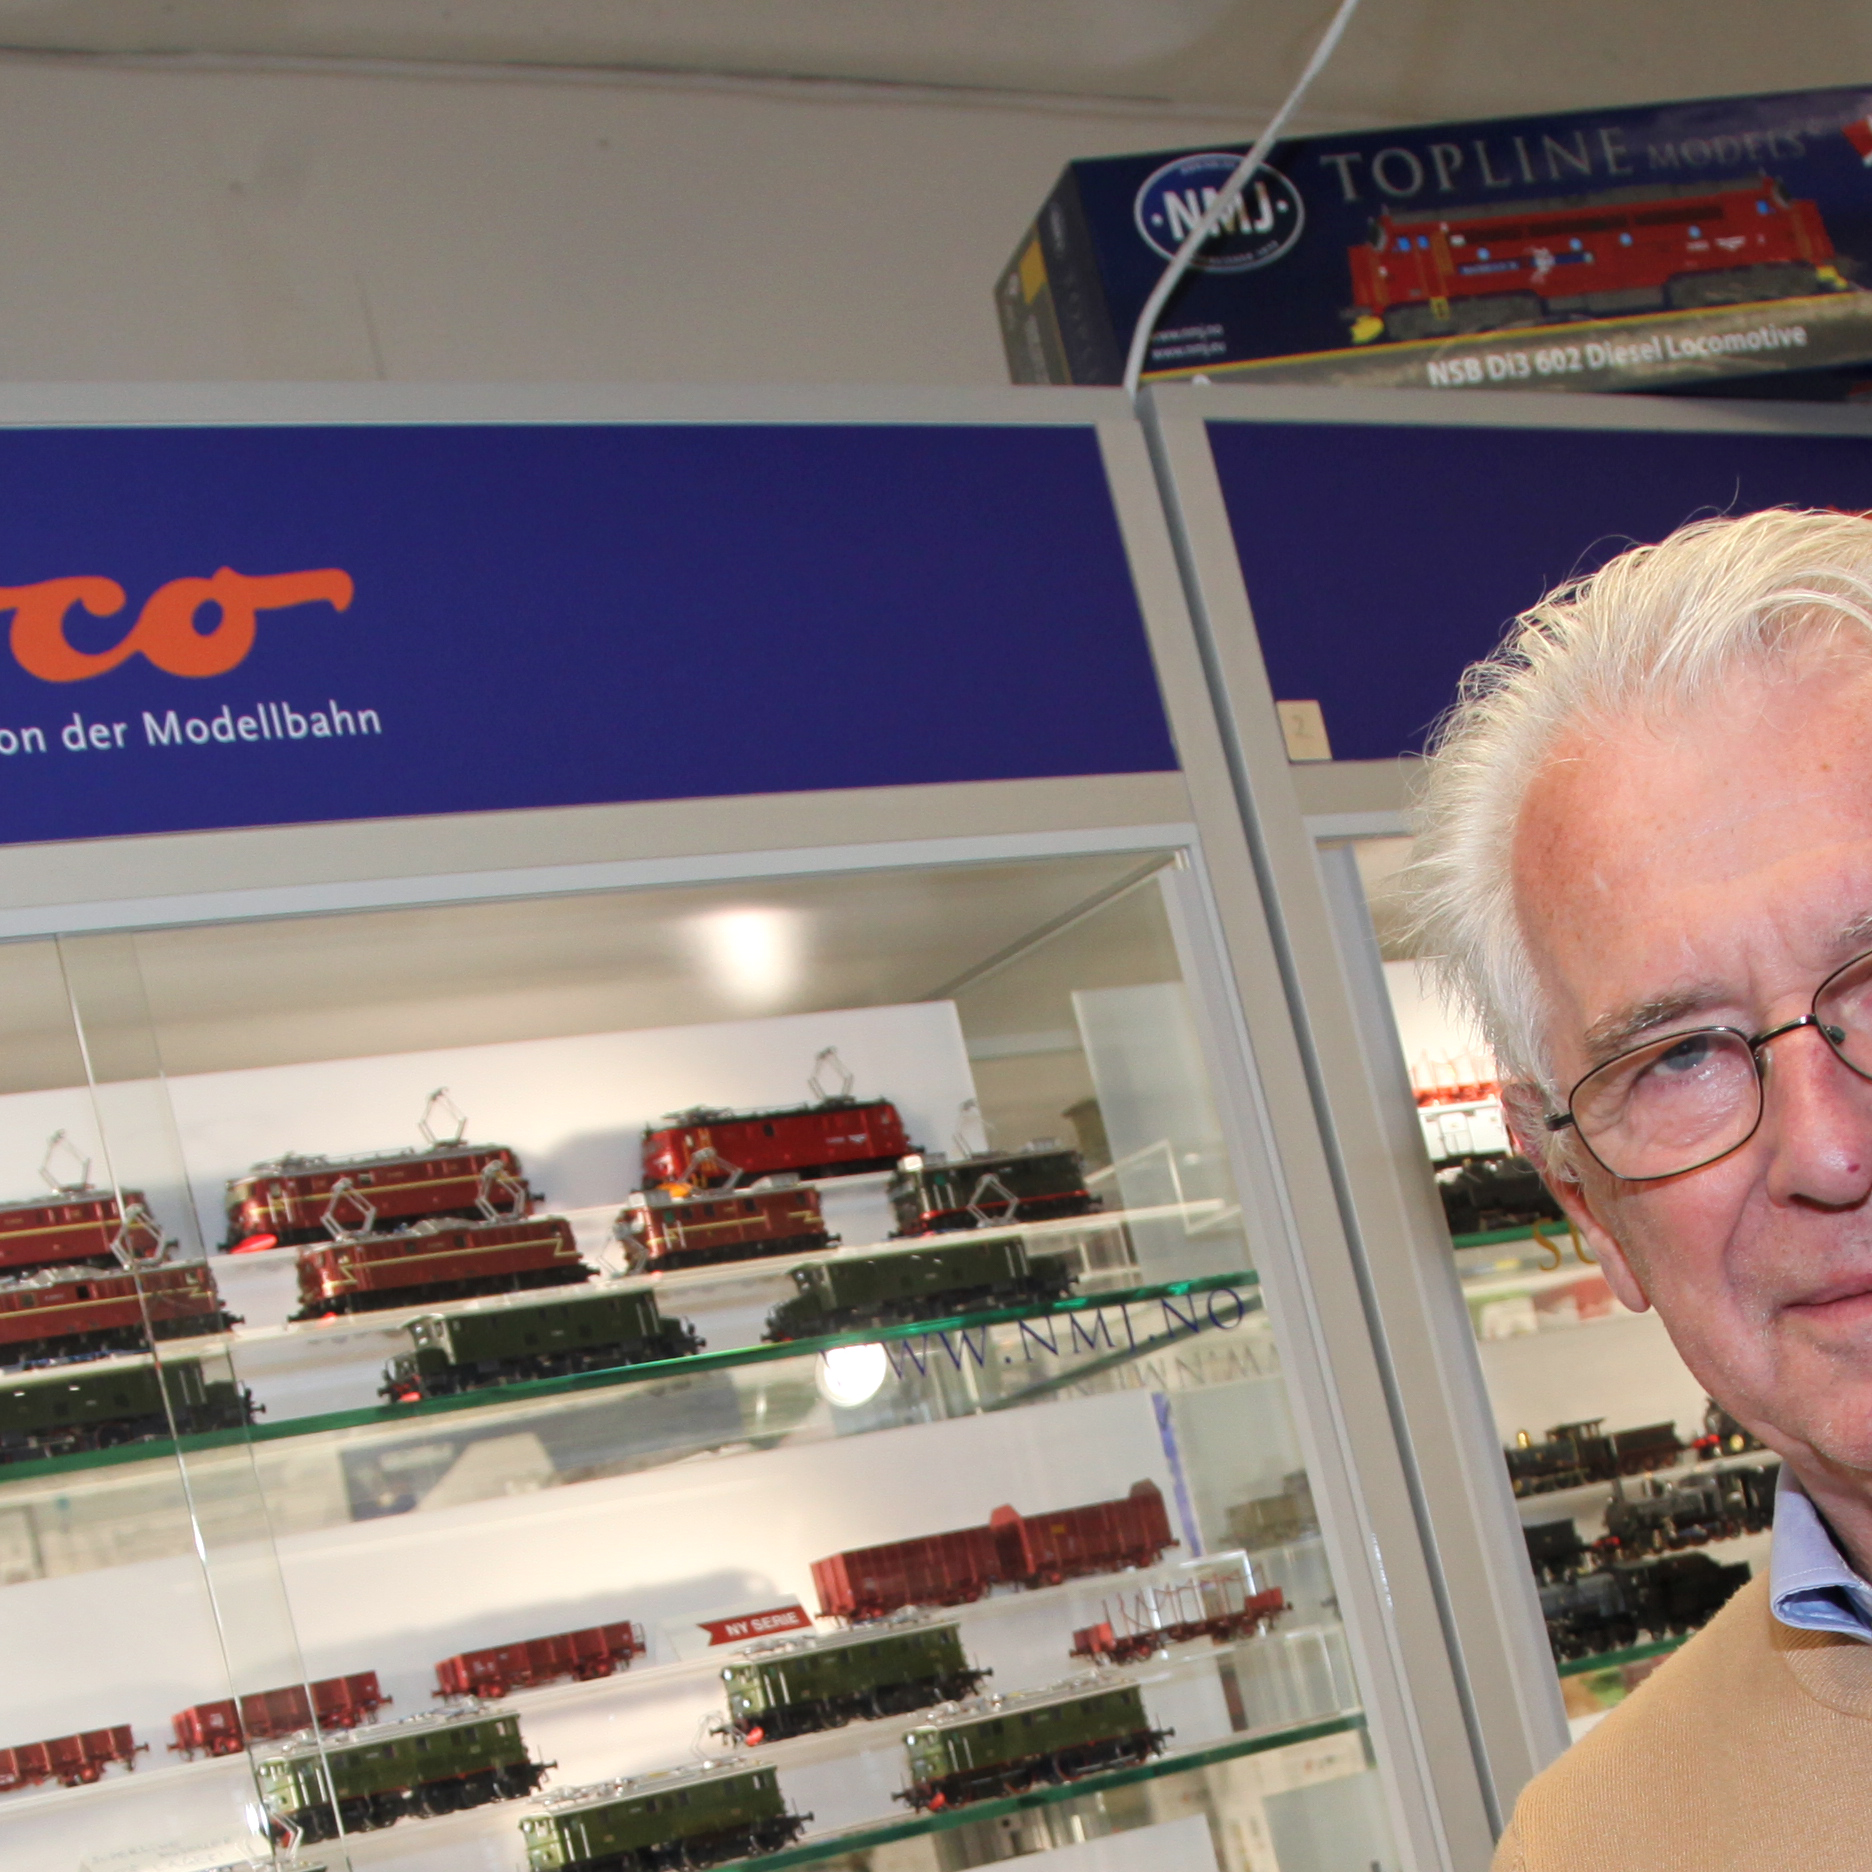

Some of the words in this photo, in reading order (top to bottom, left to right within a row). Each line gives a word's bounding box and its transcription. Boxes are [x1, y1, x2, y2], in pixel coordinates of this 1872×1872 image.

[1319, 126, 1633, 201] TOPLINE
[1428, 353, 1484, 387] NSB
[1533, 344, 1583, 376] 602
[1585, 336, 1661, 370] Diesel
[1664, 324, 1809, 362] Locomotive
[61, 712, 129, 752] der
[141, 700, 383, 747] Modellbahn
[724, 1621, 749, 1637] NY
[750, 1611, 800, 1632] SERIE
